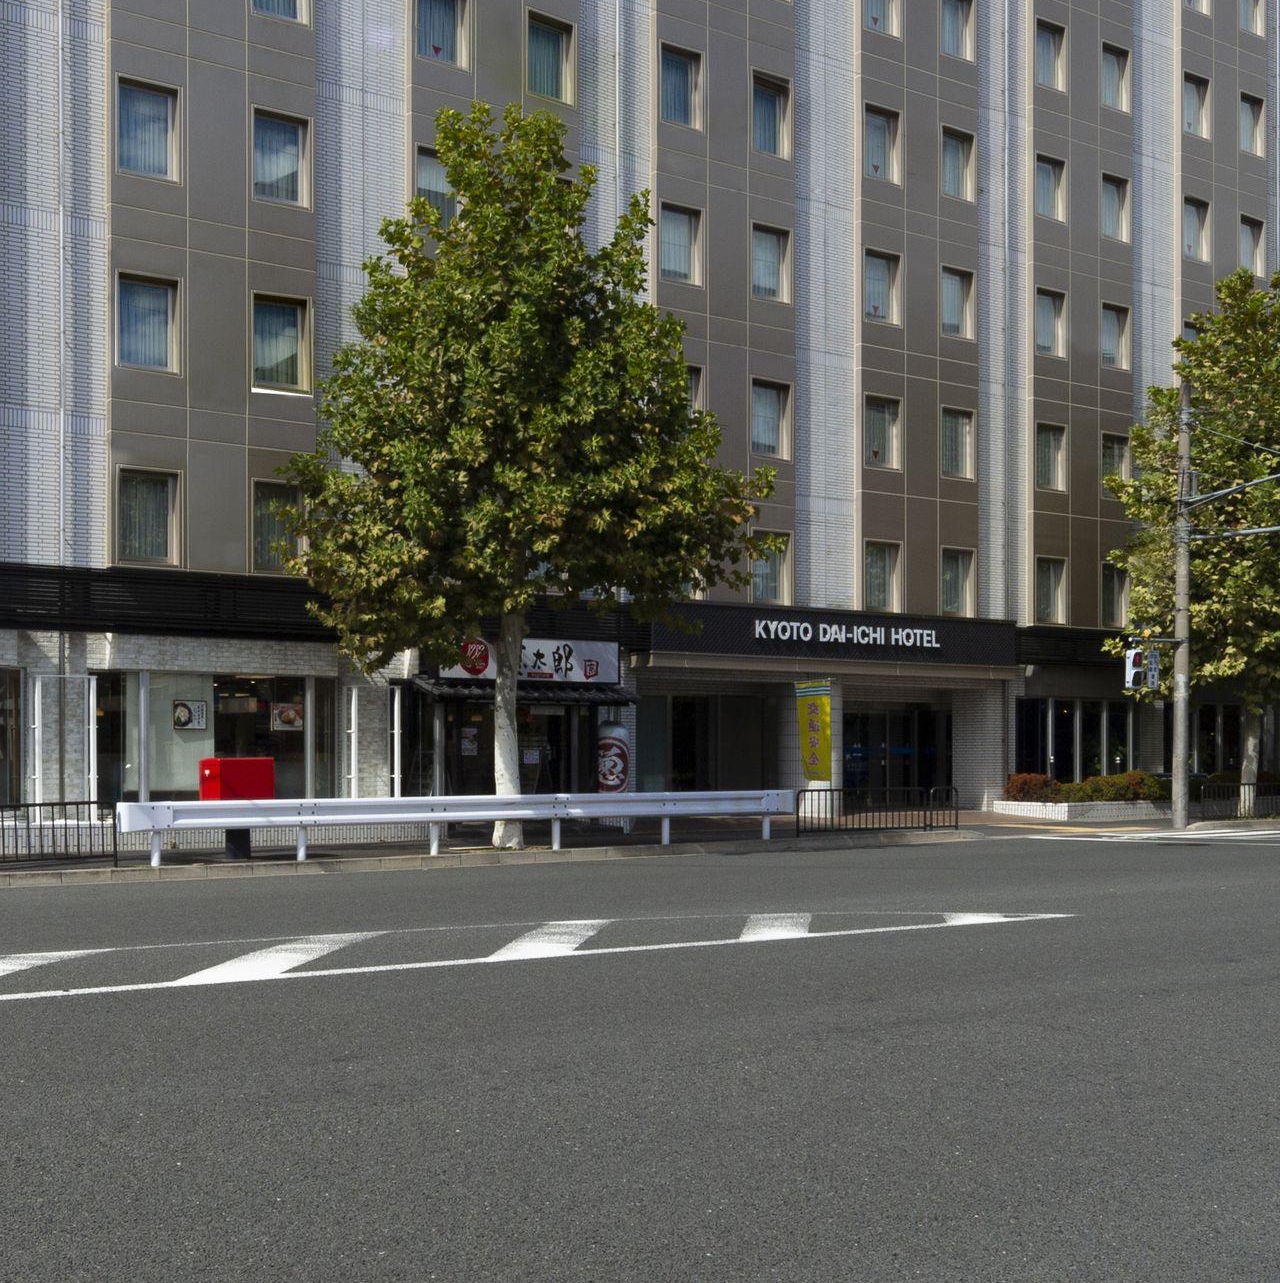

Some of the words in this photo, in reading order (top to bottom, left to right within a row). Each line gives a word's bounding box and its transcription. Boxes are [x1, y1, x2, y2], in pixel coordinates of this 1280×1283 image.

[755, 620, 812, 642] KYOTO
[819, 623, 885, 645] DAI-ICHI
[891, 627, 941, 648] HOTEL
